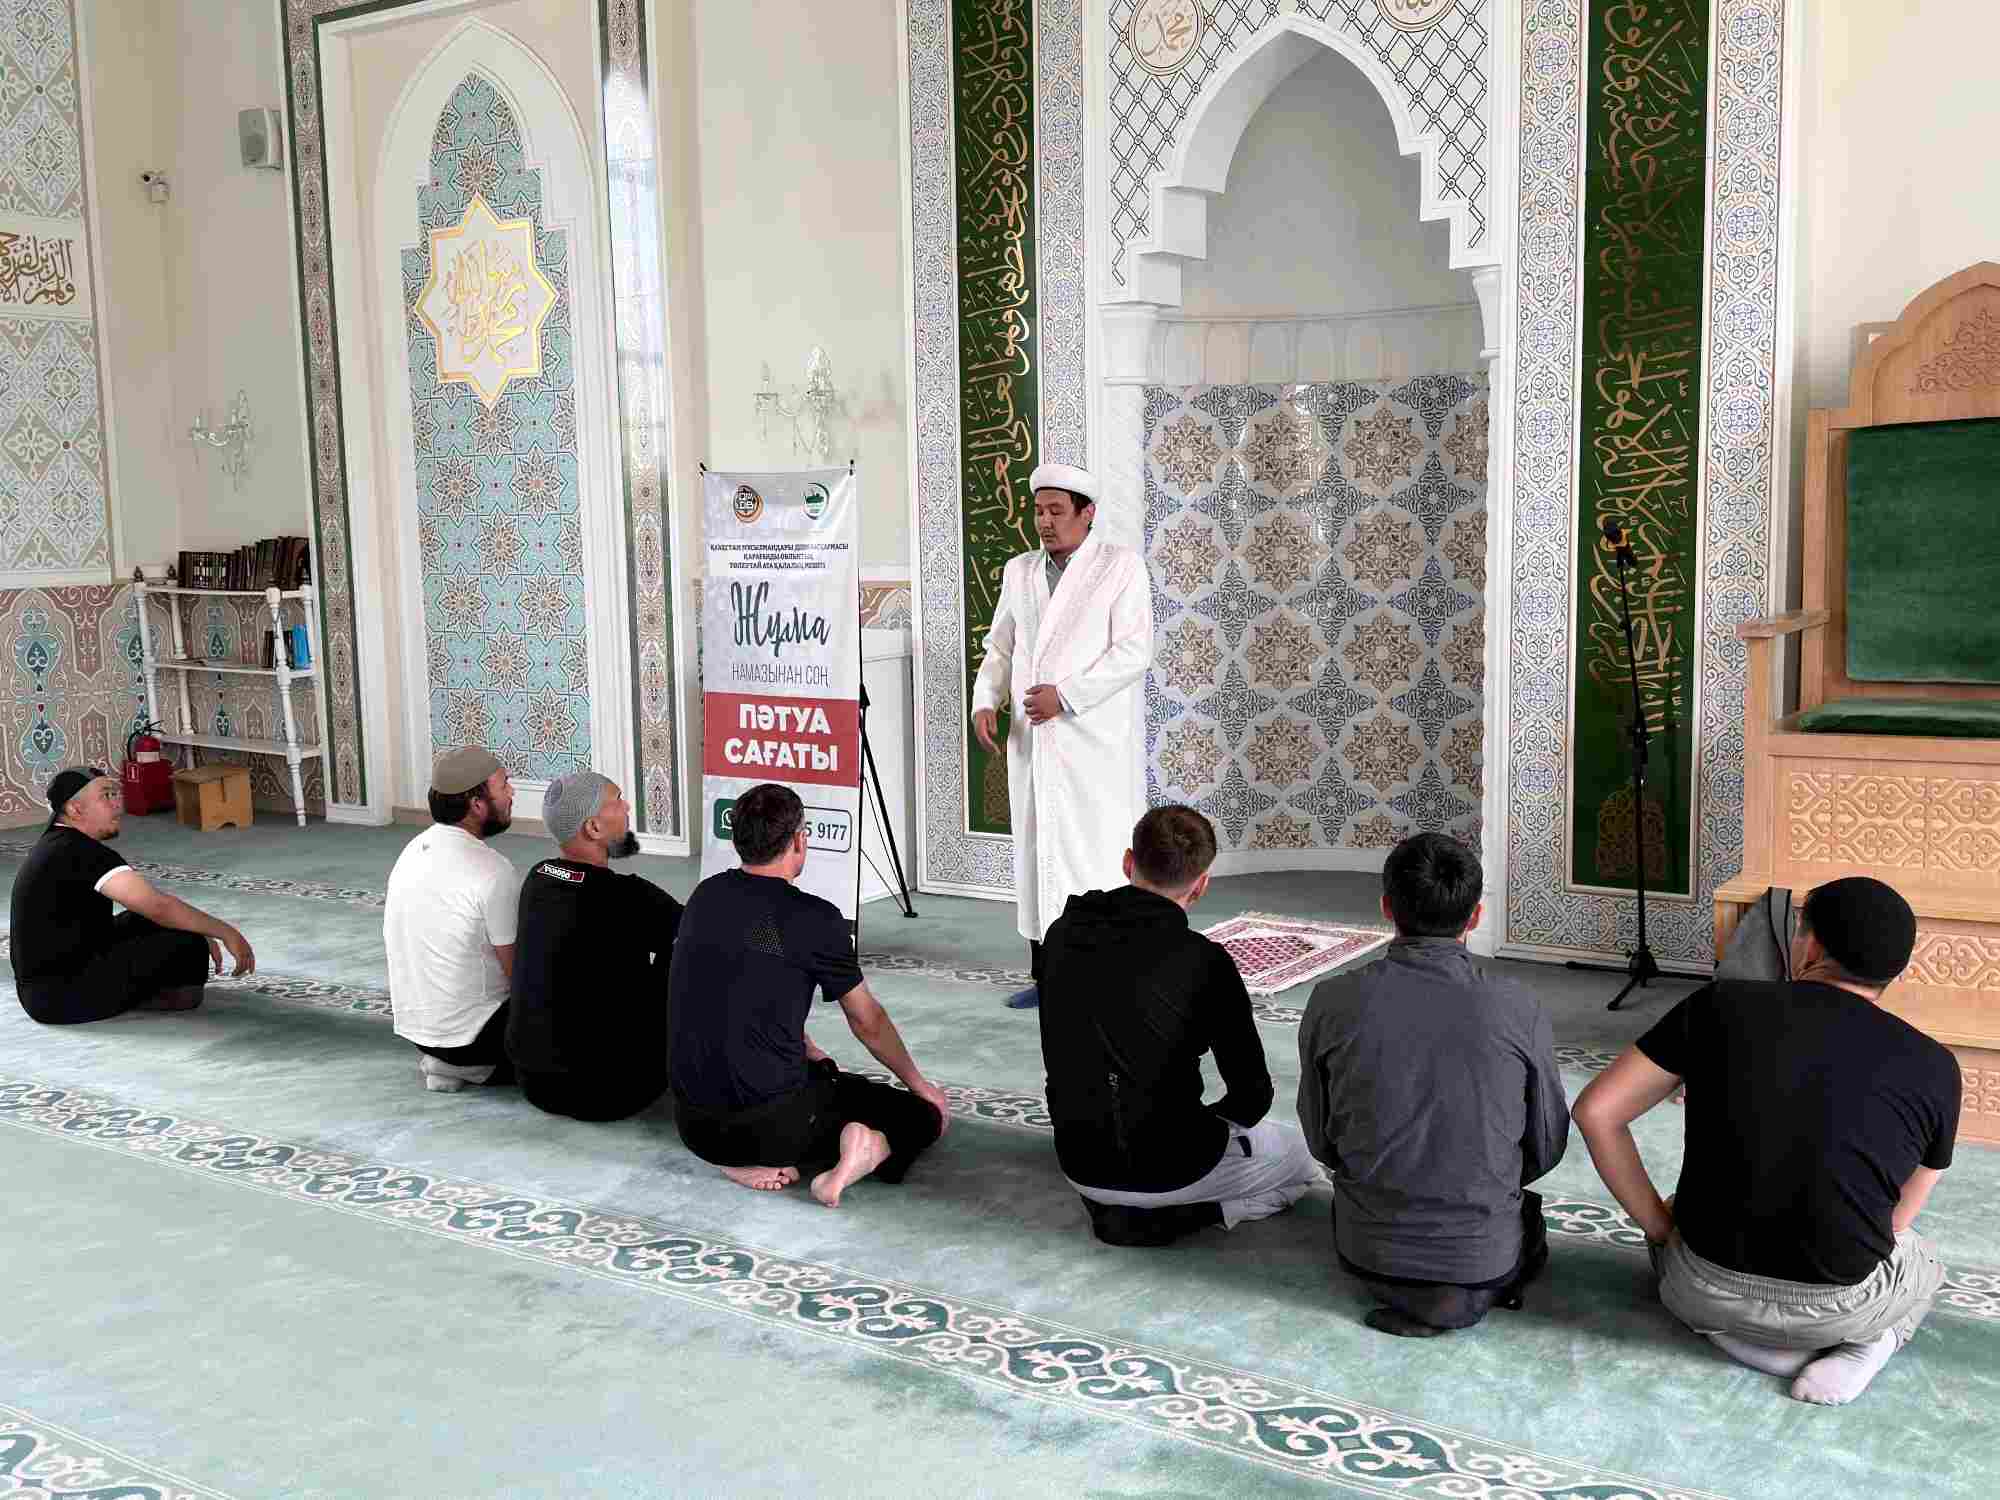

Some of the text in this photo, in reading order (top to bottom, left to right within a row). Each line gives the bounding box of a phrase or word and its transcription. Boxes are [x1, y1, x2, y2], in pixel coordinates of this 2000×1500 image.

[732, 663, 830, 688] НАМАЗЫНАН СОҢ
[739, 703, 832, 734] ПӘТУА
[724, 738, 838, 771] САҒАТЫ
[817, 822, 848, 841] 9177
